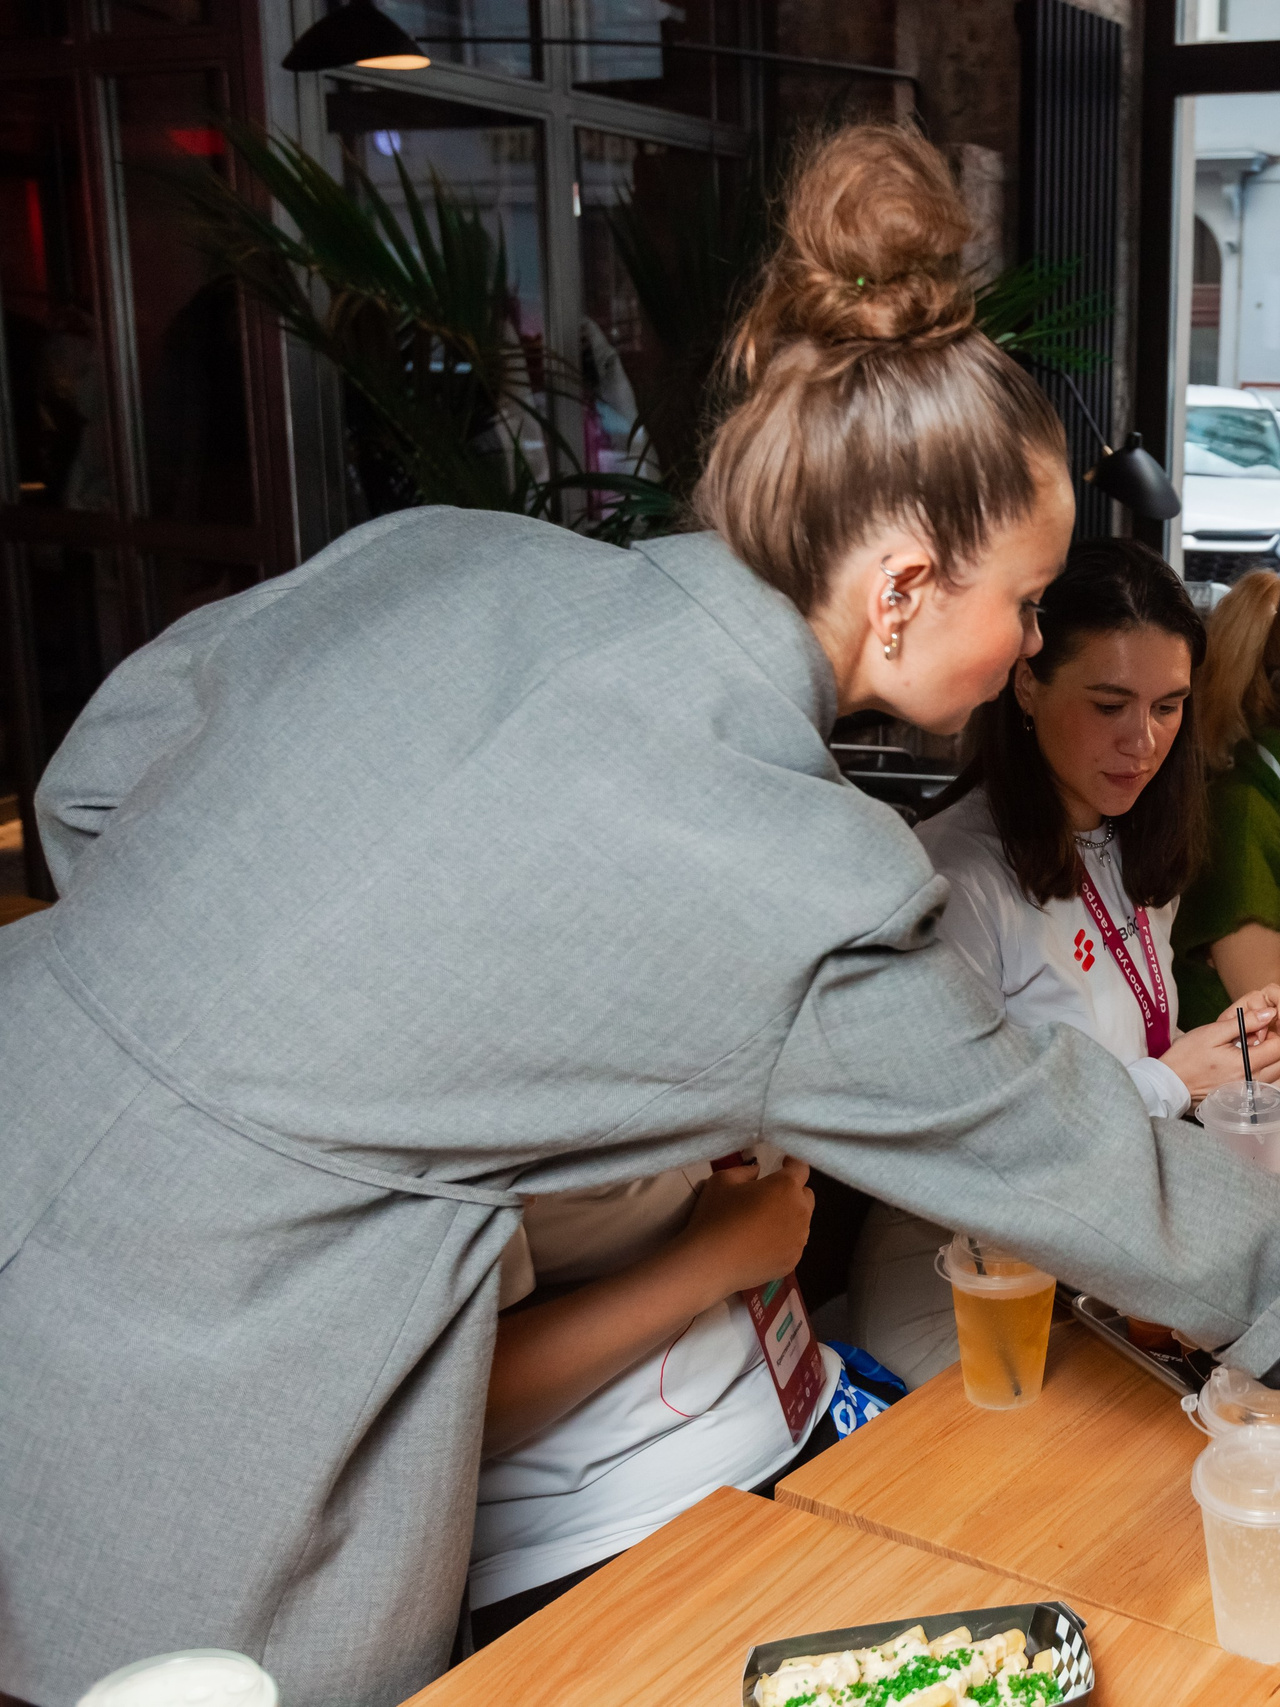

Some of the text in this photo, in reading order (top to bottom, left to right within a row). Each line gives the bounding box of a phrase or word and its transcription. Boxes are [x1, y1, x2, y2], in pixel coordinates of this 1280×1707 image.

[1081, 882, 1113, 938] гастро
[1115, 947, 1154, 1028] гастротур
[1142, 925, 1167, 1013] гастротур
